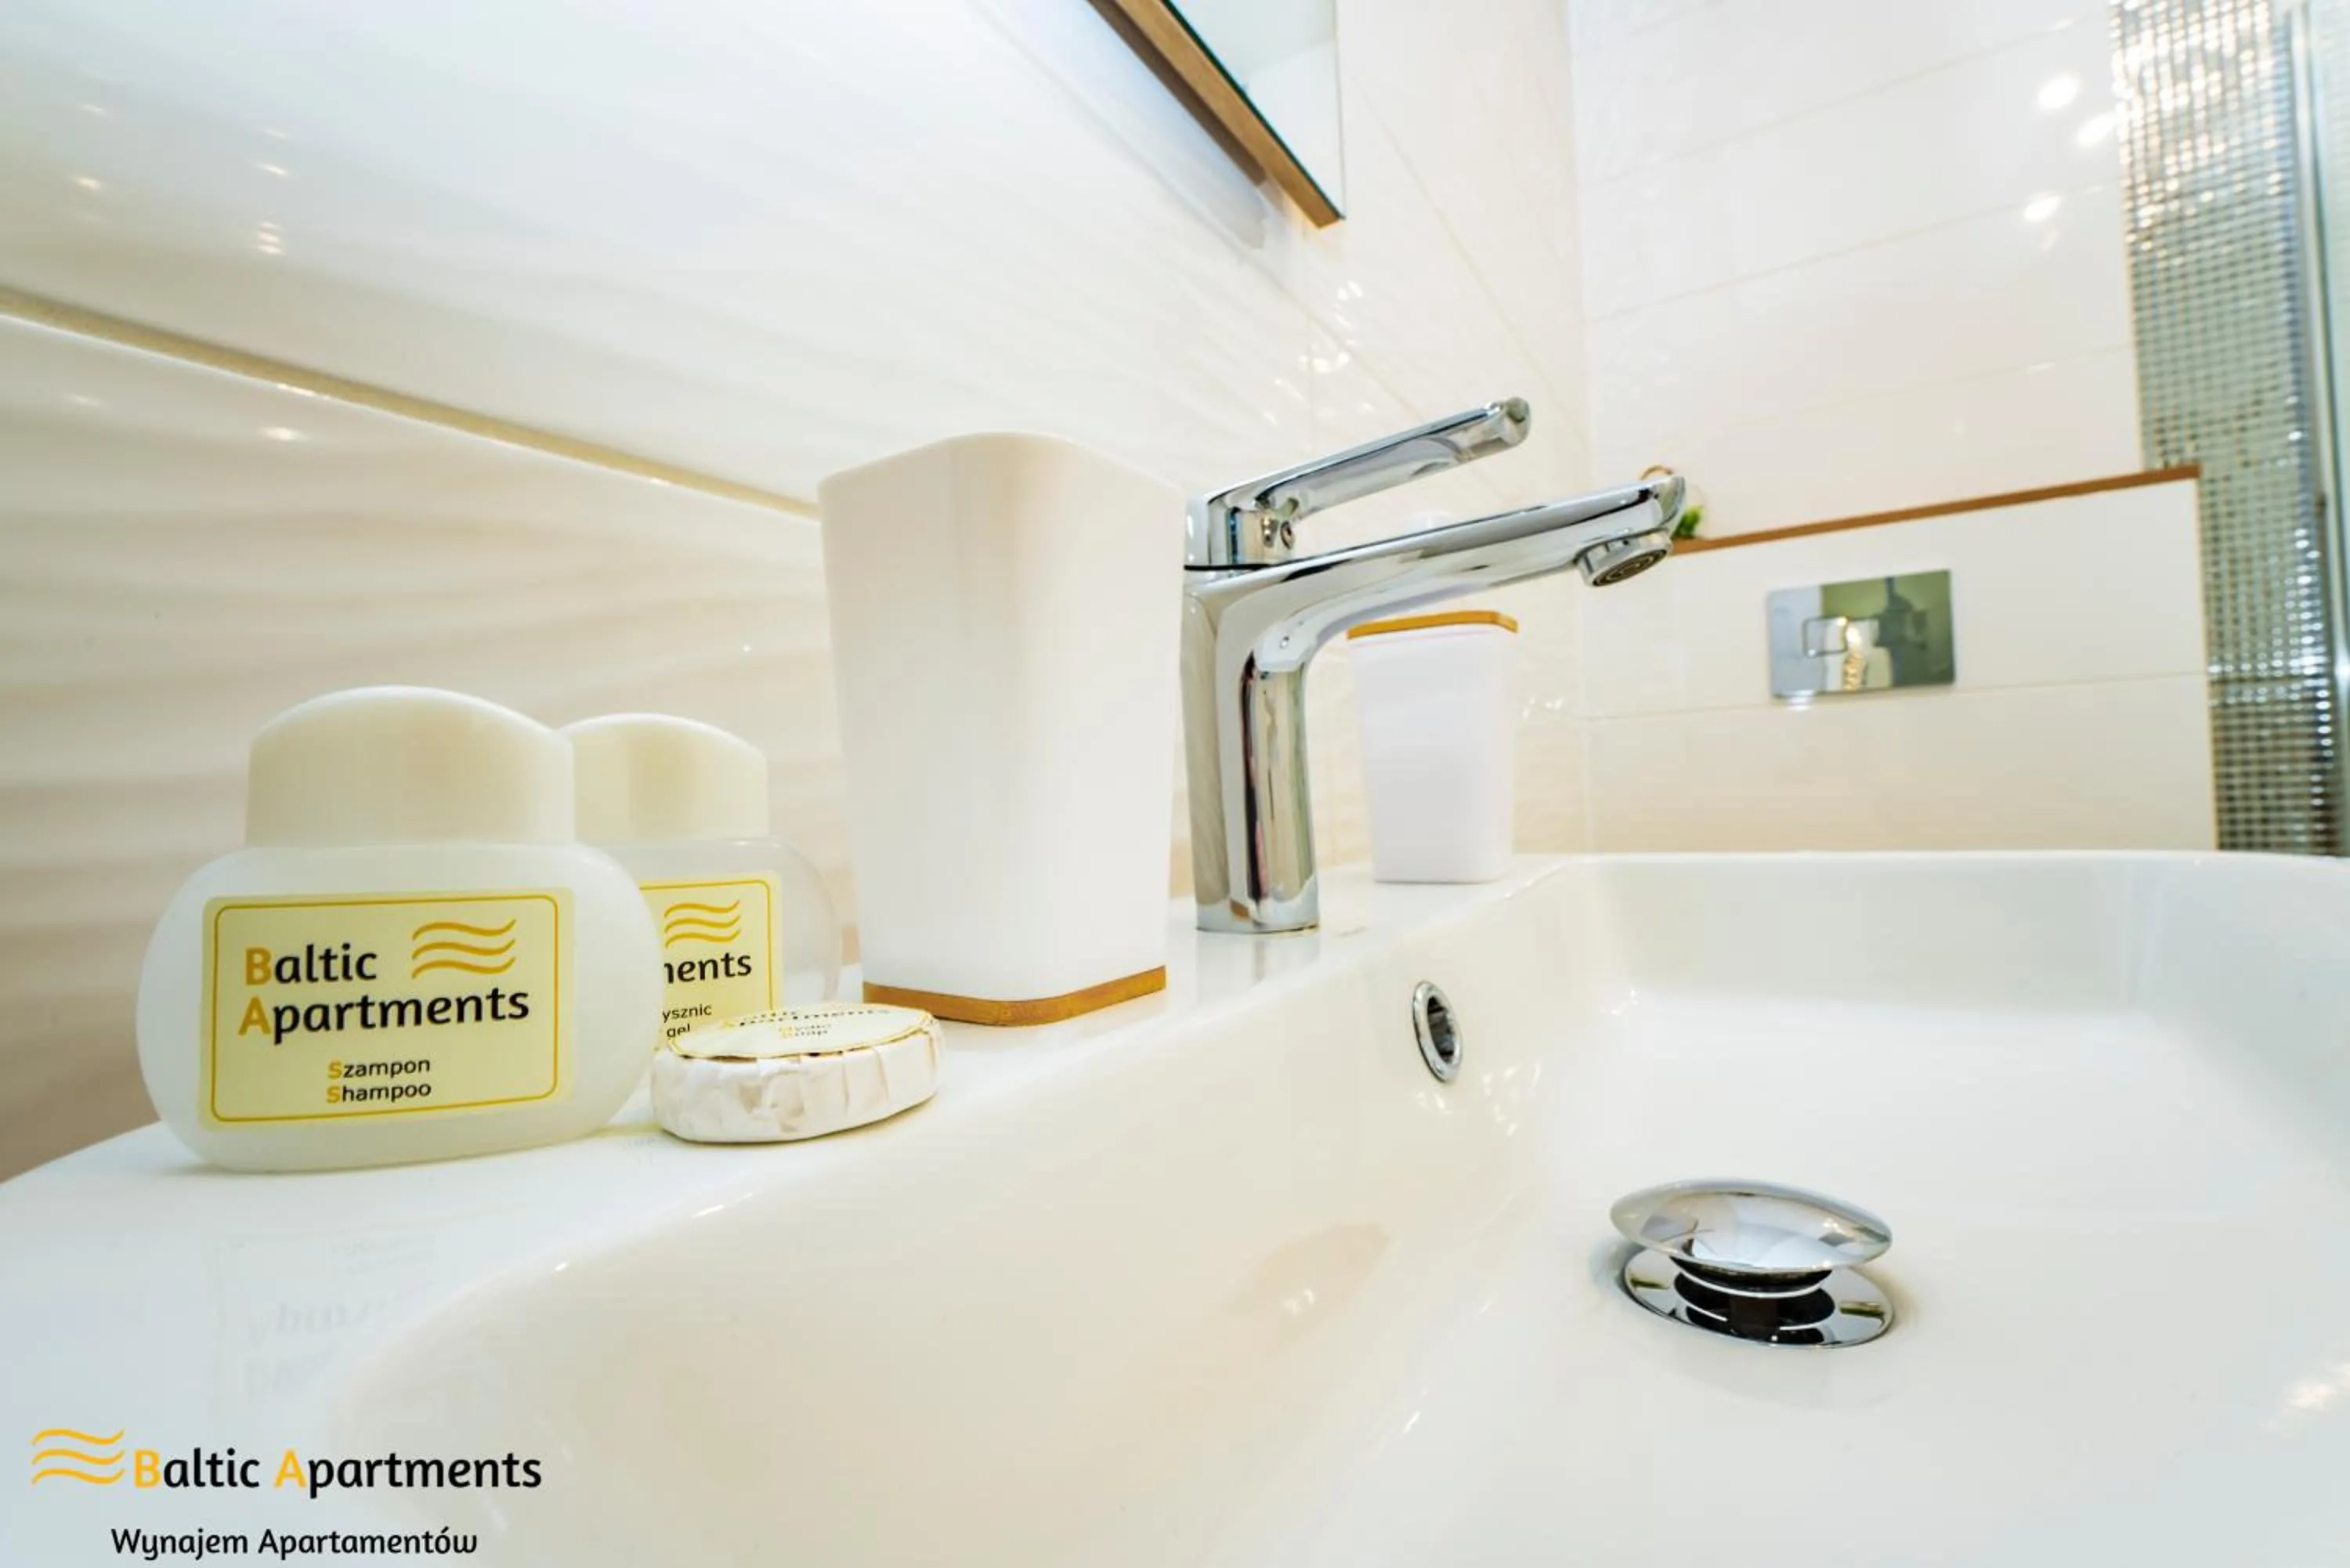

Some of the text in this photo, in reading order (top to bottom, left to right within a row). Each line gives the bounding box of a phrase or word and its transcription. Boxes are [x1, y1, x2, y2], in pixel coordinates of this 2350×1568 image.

[245, 942, 378, 986] Baltic
[238, 987, 530, 1045] Apartments
[327, 1057, 431, 1080] Szampon
[326, 1082, 432, 1104] Shampoo
